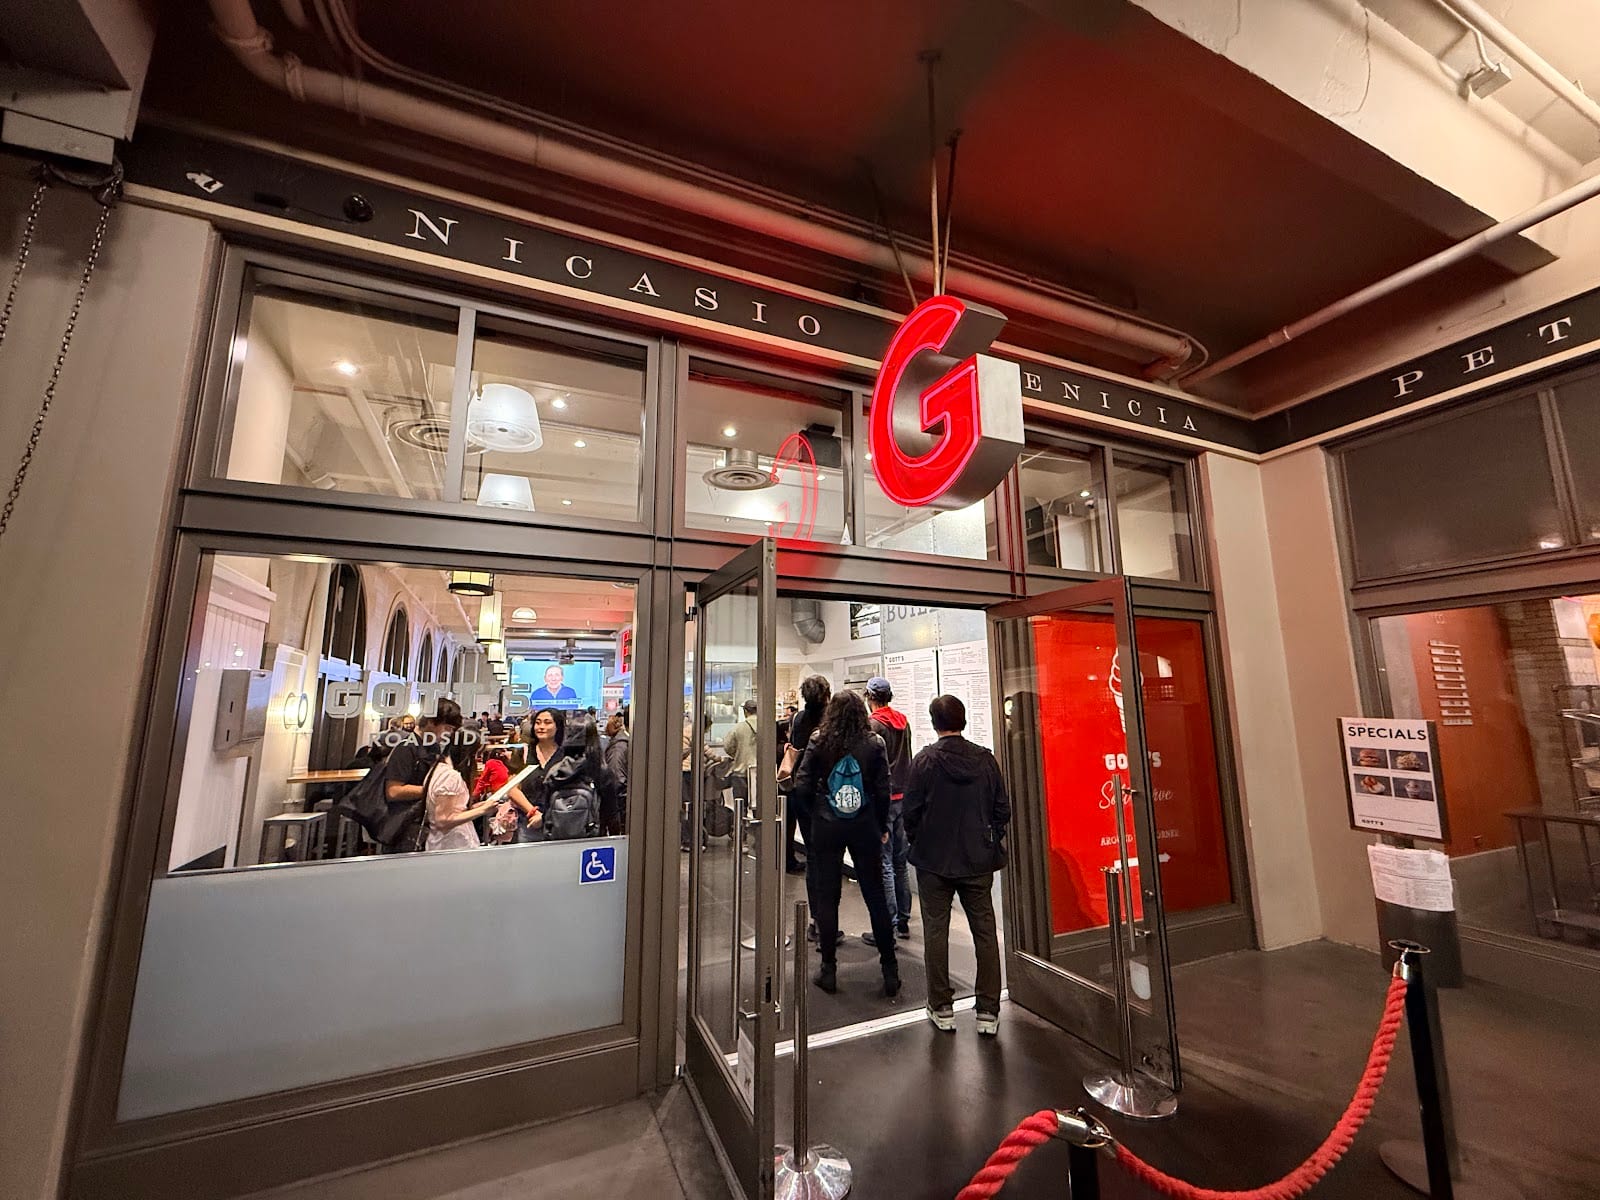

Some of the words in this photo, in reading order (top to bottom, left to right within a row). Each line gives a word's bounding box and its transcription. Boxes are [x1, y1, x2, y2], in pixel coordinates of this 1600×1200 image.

[405, 208, 822, 337] NICASIO
[868, 294, 983, 508] G
[1023, 371, 1198, 432] ENICIA
[325, 681, 532, 719] GOTT'S
[368, 731, 491, 748] ROADSIDE
[1347, 726, 1427, 741] SPECIALS
[1104, 751, 1162, 771] GO'S
